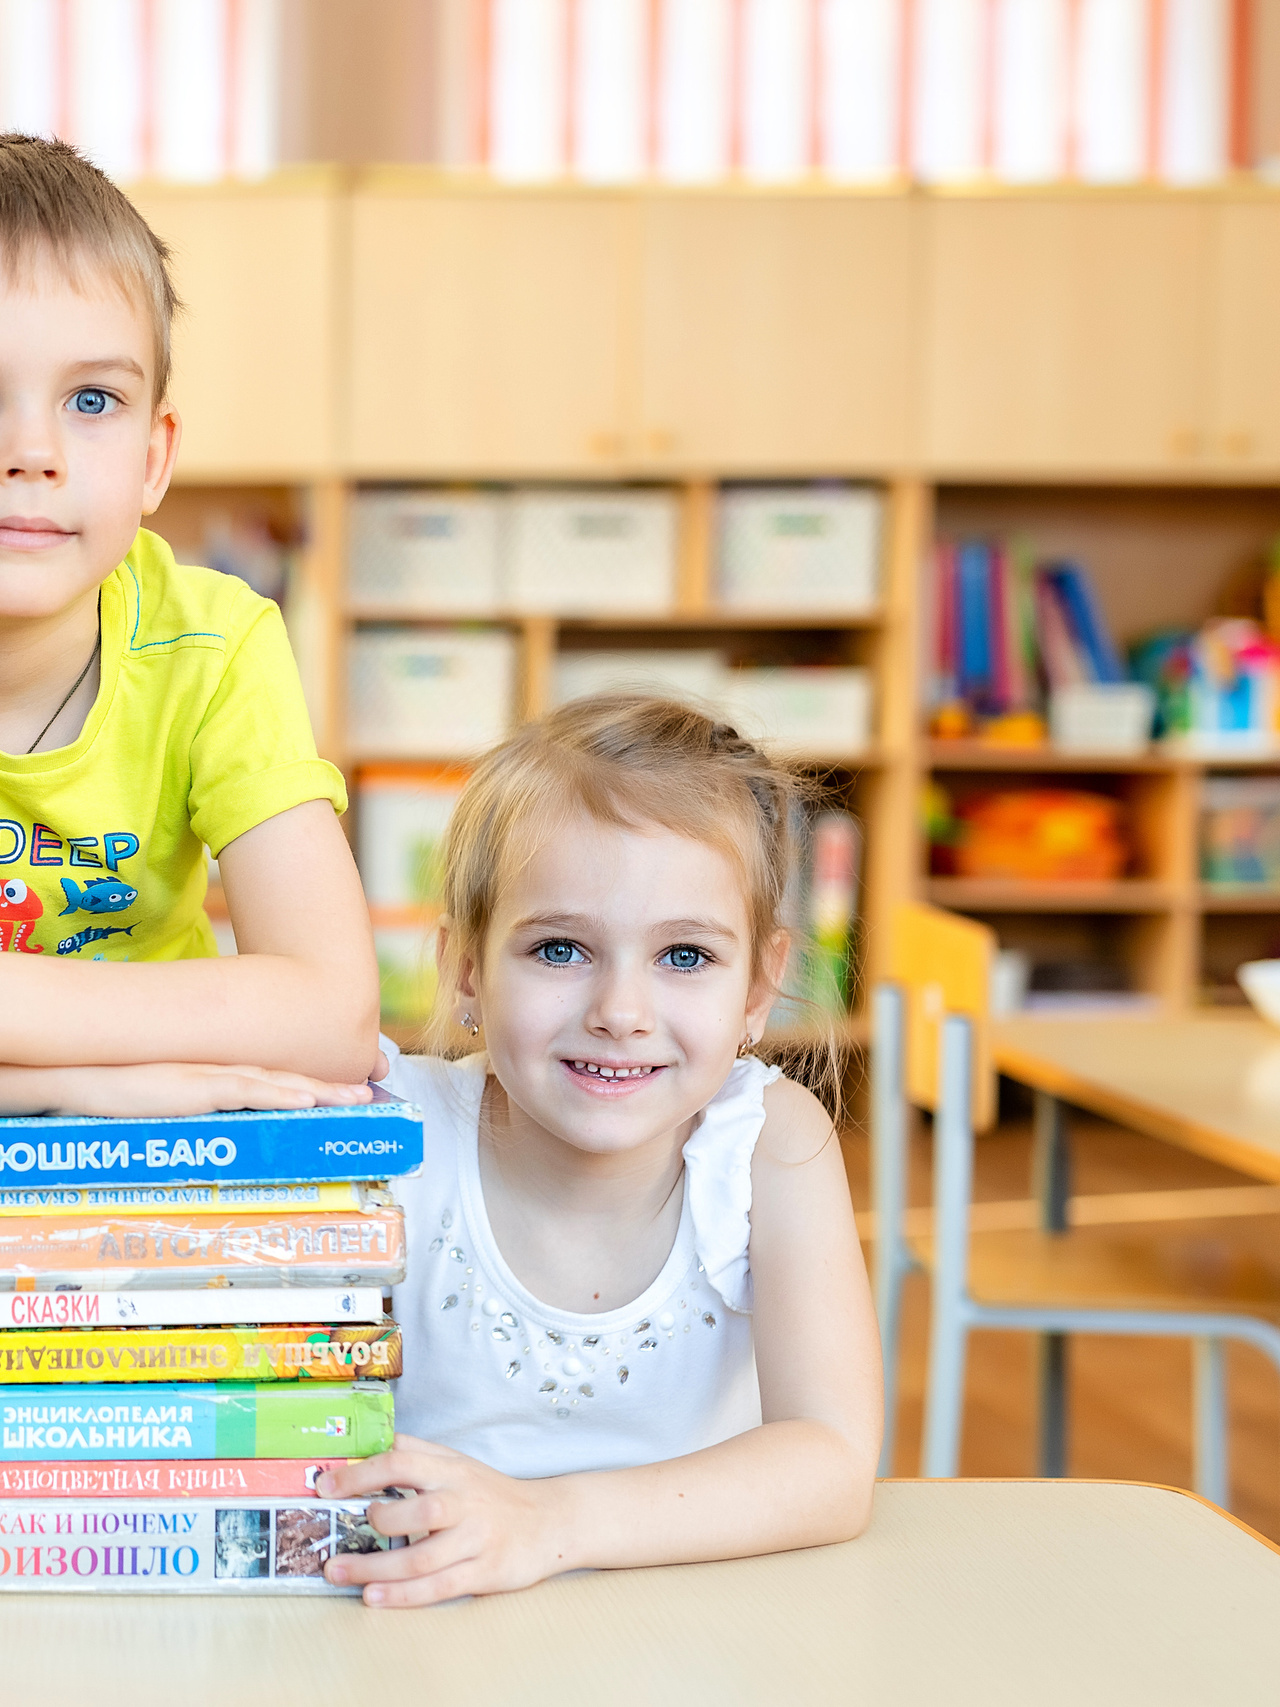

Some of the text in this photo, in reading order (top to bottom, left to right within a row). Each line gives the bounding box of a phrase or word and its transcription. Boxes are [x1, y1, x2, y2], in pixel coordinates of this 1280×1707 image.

[88, 1187, 212, 1206] НАРОДНЫЕ
[220, 1185, 319, 1203] РУССКИЕ
[11, 1294, 100, 1324] СКАЗКИ
[243, 1341, 390, 1368] БОЛЬШАЯ
[3, 1405, 193, 1425] ЭНЦИКЛОПЕДИЯ
[3, 1426, 193, 1449] ШКОЛЬНИКА
[168, 1468, 248, 1490] КНИГА
[53, 1512, 74, 1535] И
[81, 1512, 200, 1536] ПОЧЕМУ
